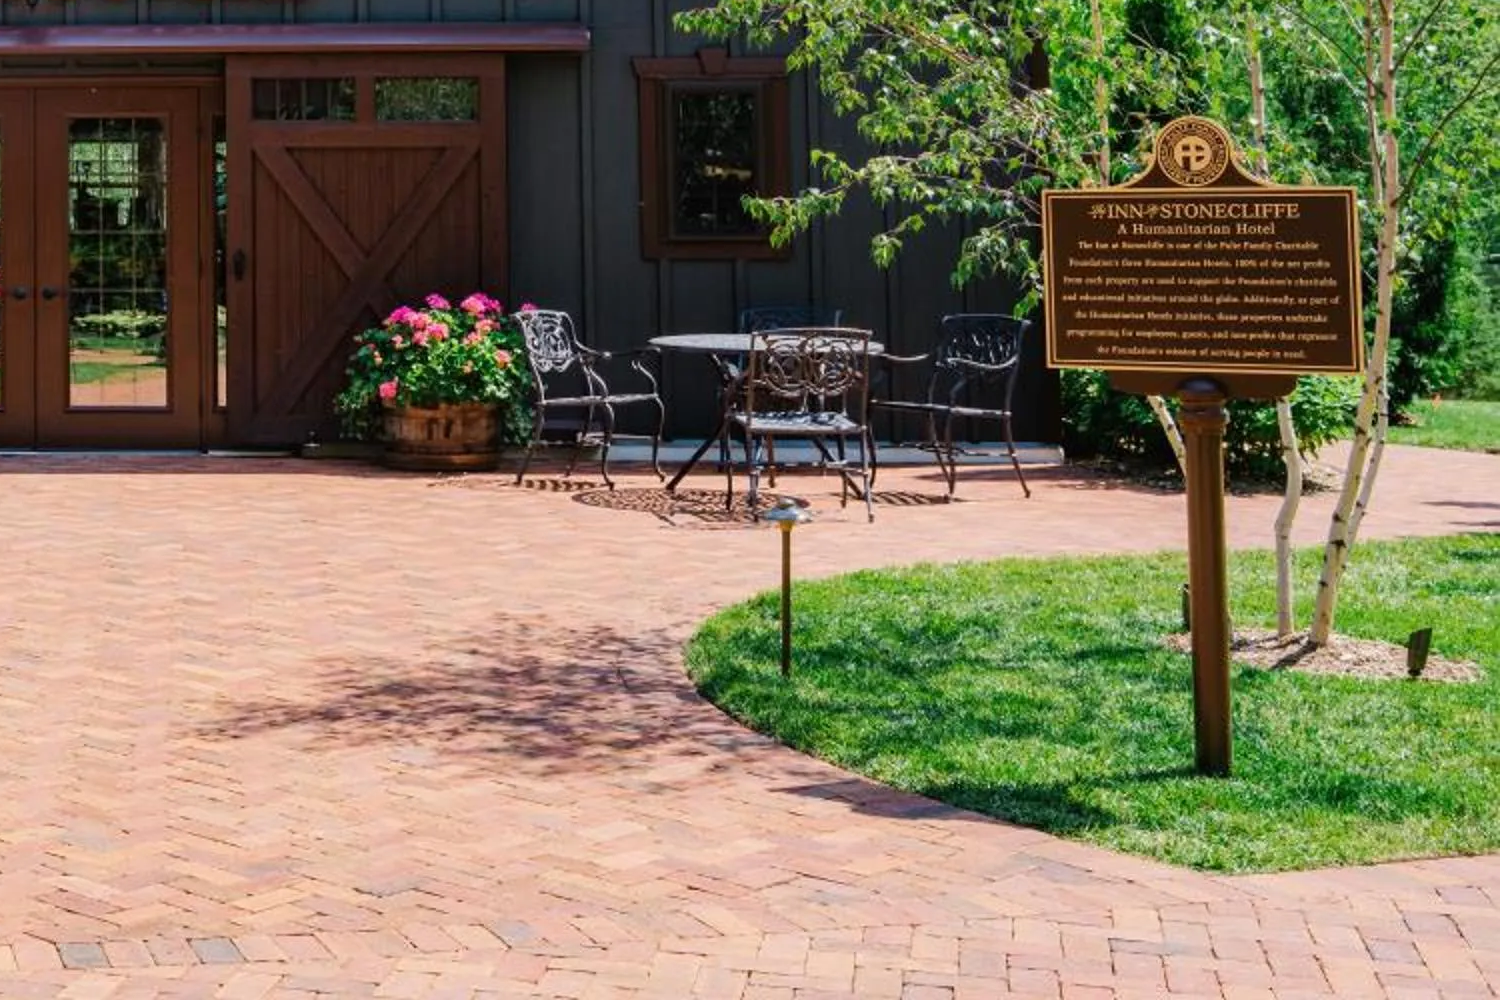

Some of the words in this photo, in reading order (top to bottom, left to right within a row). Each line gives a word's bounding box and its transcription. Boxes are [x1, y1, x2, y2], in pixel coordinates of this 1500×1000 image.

[1107, 203, 1143, 219] INN
[1160, 203, 1301, 219] STONECLIFFE
[1117, 223, 1128, 235] A
[1133, 223, 1231, 235] Humanitarian
[1236, 221, 1276, 235] Hotel
